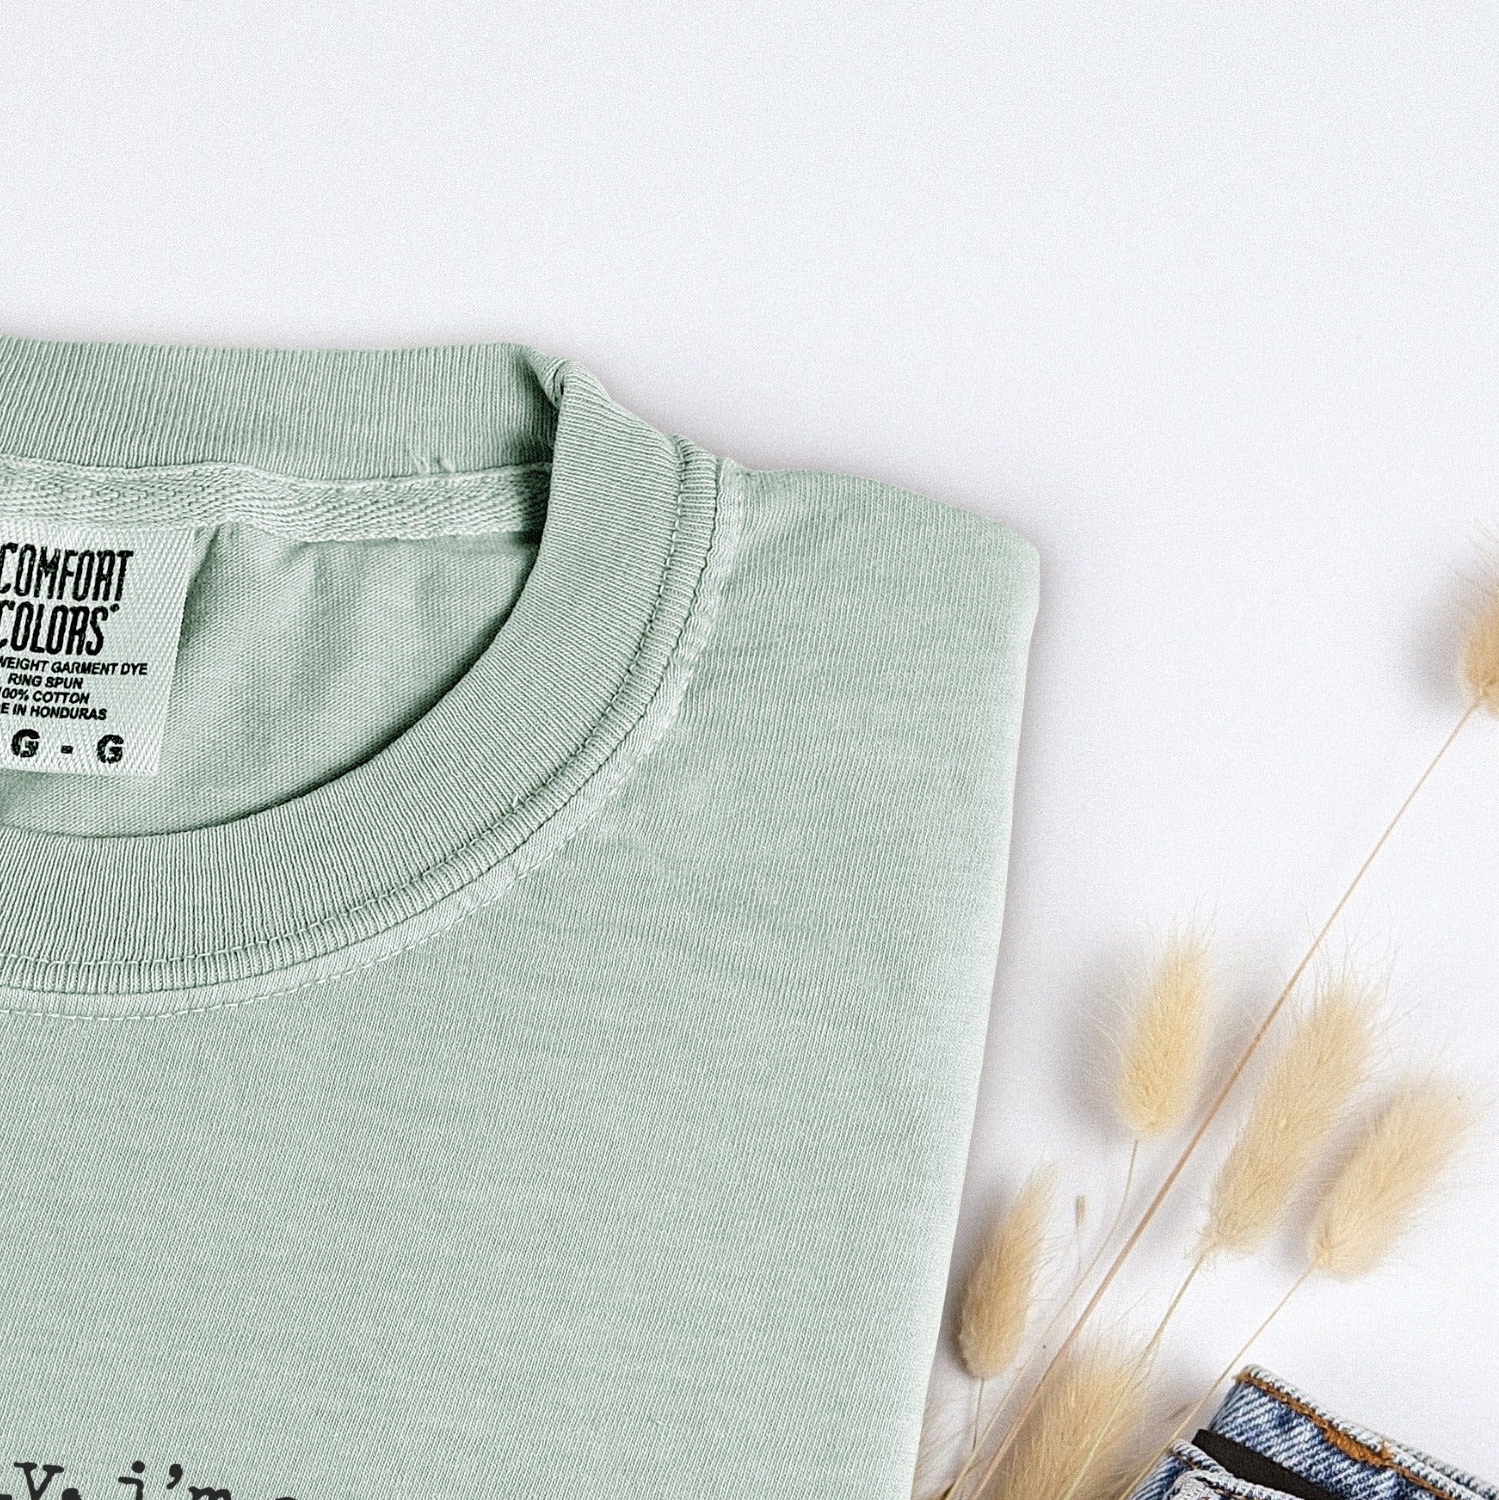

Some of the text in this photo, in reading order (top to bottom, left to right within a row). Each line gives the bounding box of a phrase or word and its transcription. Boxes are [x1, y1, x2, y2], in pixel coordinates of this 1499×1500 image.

[51, 661, 119, 675] GARMENT
[120, 663, 148, 675] DYE
[8, 673, 84, 690] RING SPUN
[32, 690, 90, 704] COTTON
[13, 704, 27, 716] IN
[30, 705, 108, 720] HONDURAS
